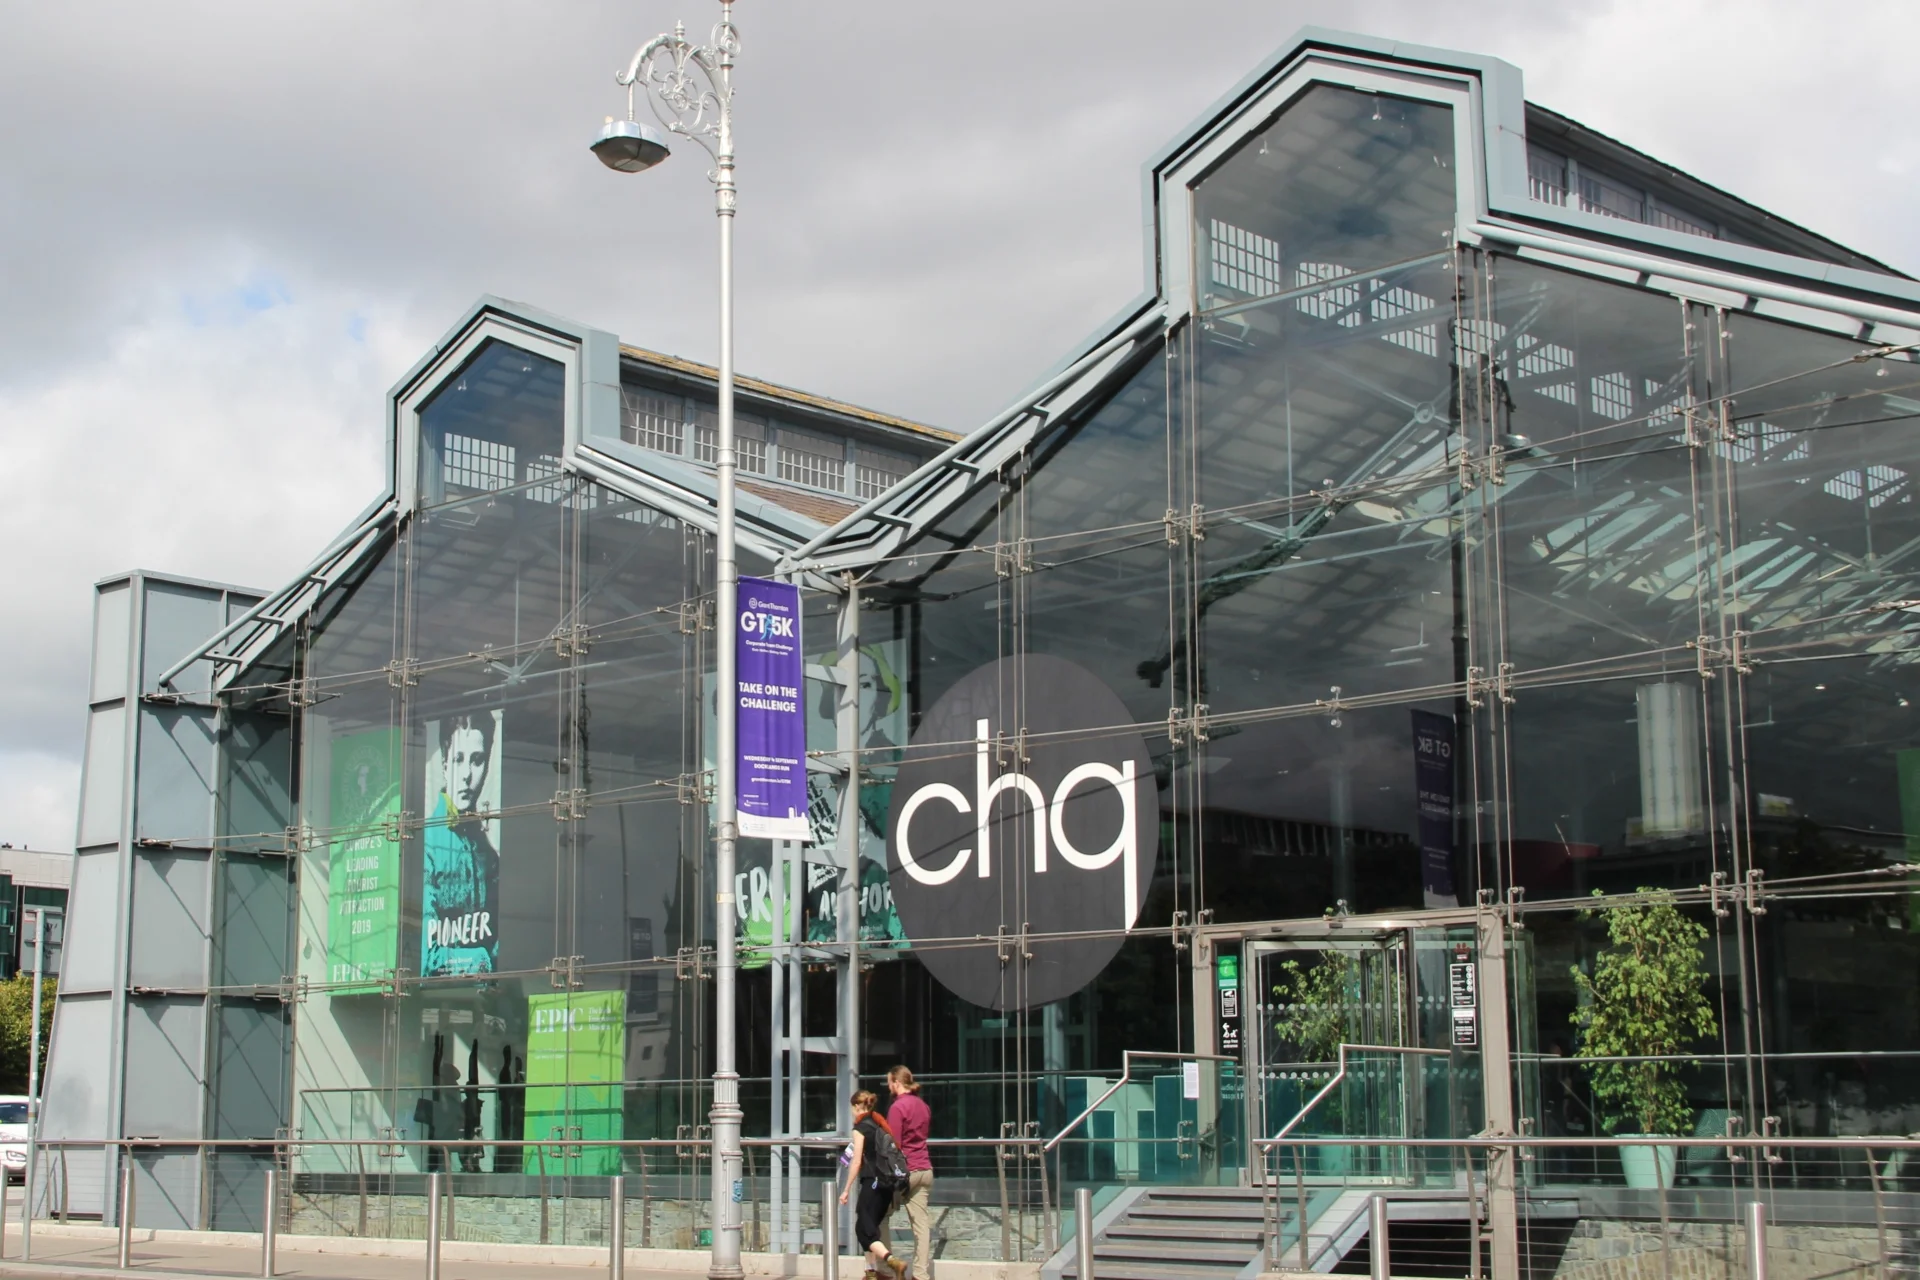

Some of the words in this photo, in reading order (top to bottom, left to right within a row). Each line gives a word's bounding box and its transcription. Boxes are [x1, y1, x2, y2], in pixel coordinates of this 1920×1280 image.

[738, 681, 763, 694] TAKE
[764, 684, 779, 696] ON
[780, 686, 797, 698] THE
[740, 697, 796, 713] CHALLENGE
[896, 718, 1138, 934] chq
[346, 855, 379, 872] LEADING
[346, 877, 378, 893] TOURIST
[339, 896, 385, 915] ATTRACTION
[352, 919, 371, 934] 2019
[427, 911, 492, 949] PIONEER
[333, 962, 367, 982] EPIC
[536, 1008, 584, 1034] EPIC
